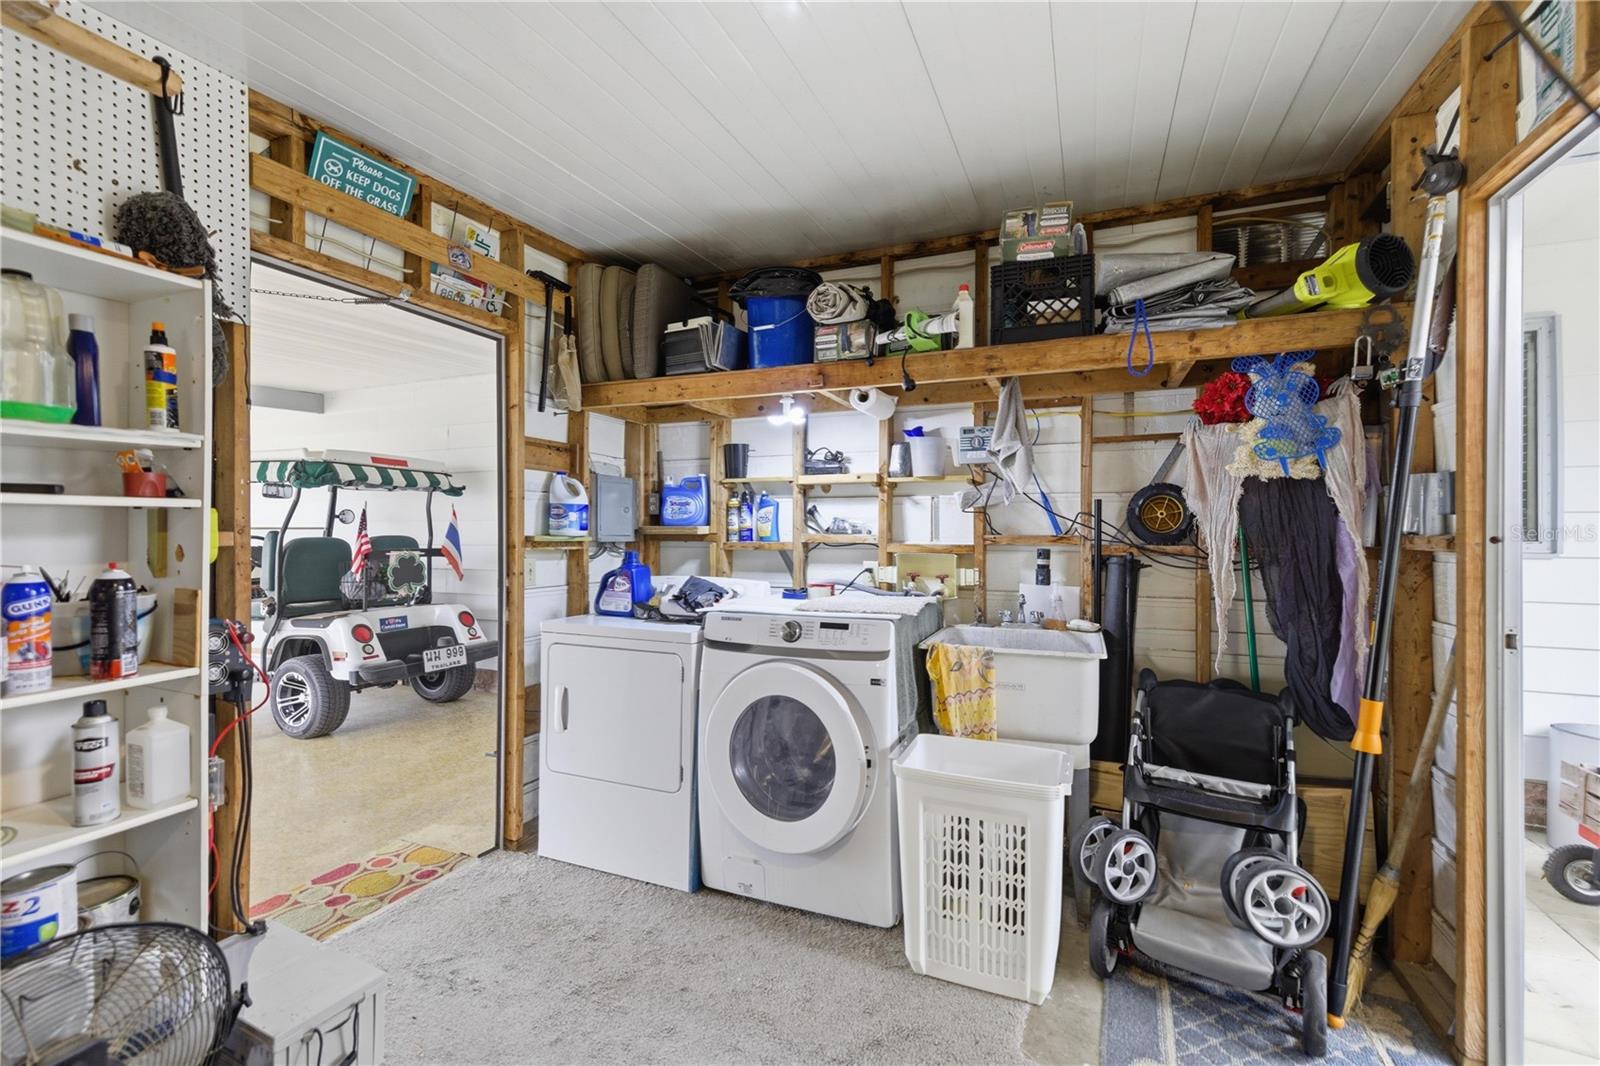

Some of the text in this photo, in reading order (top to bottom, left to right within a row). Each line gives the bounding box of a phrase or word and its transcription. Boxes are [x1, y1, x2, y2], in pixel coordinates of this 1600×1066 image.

[352, 157, 383, 179] Please
[321, 174, 398, 214] OFF THE GRASS
[345, 169, 402, 201] KEEP DOGS
[446, 646, 464, 659] 999
